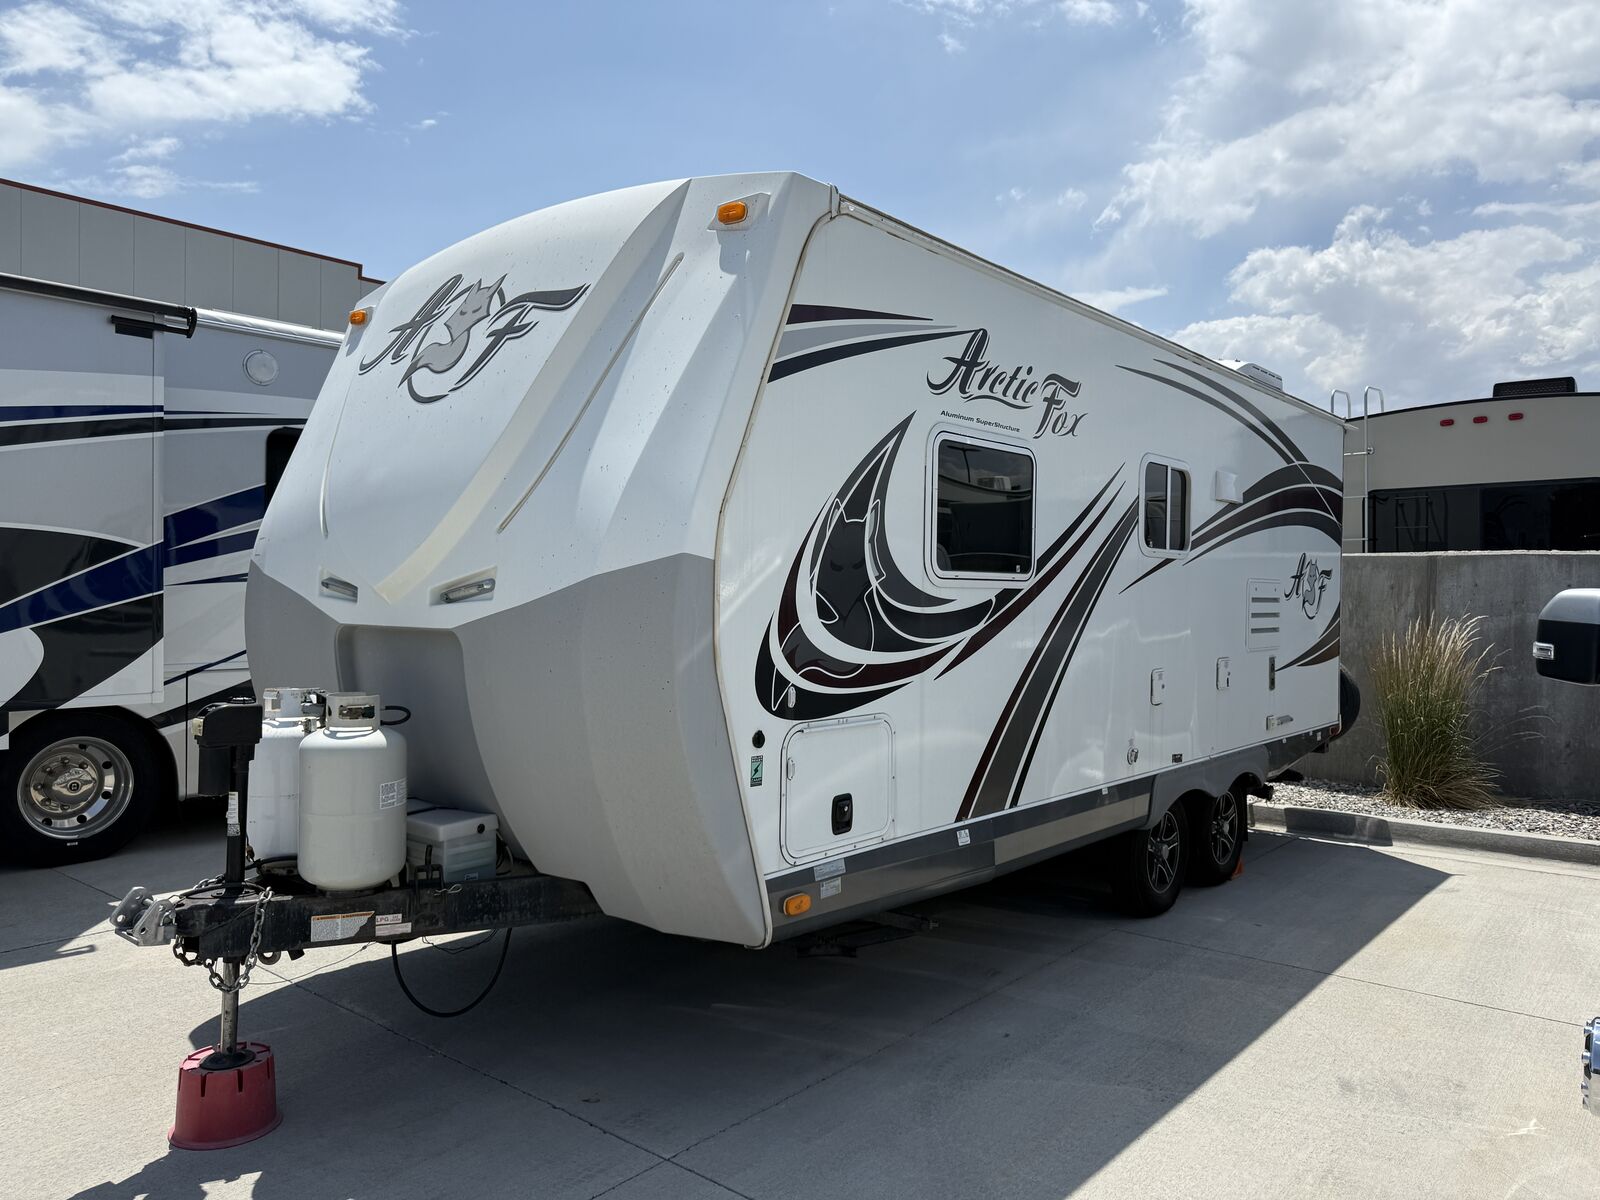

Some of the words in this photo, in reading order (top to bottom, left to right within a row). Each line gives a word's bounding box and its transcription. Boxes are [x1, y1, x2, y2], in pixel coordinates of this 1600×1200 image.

[927, 328, 1039, 404] Arctic
[1033, 373, 1088, 439] Fox
[940, 410, 975, 422] Aluminum
